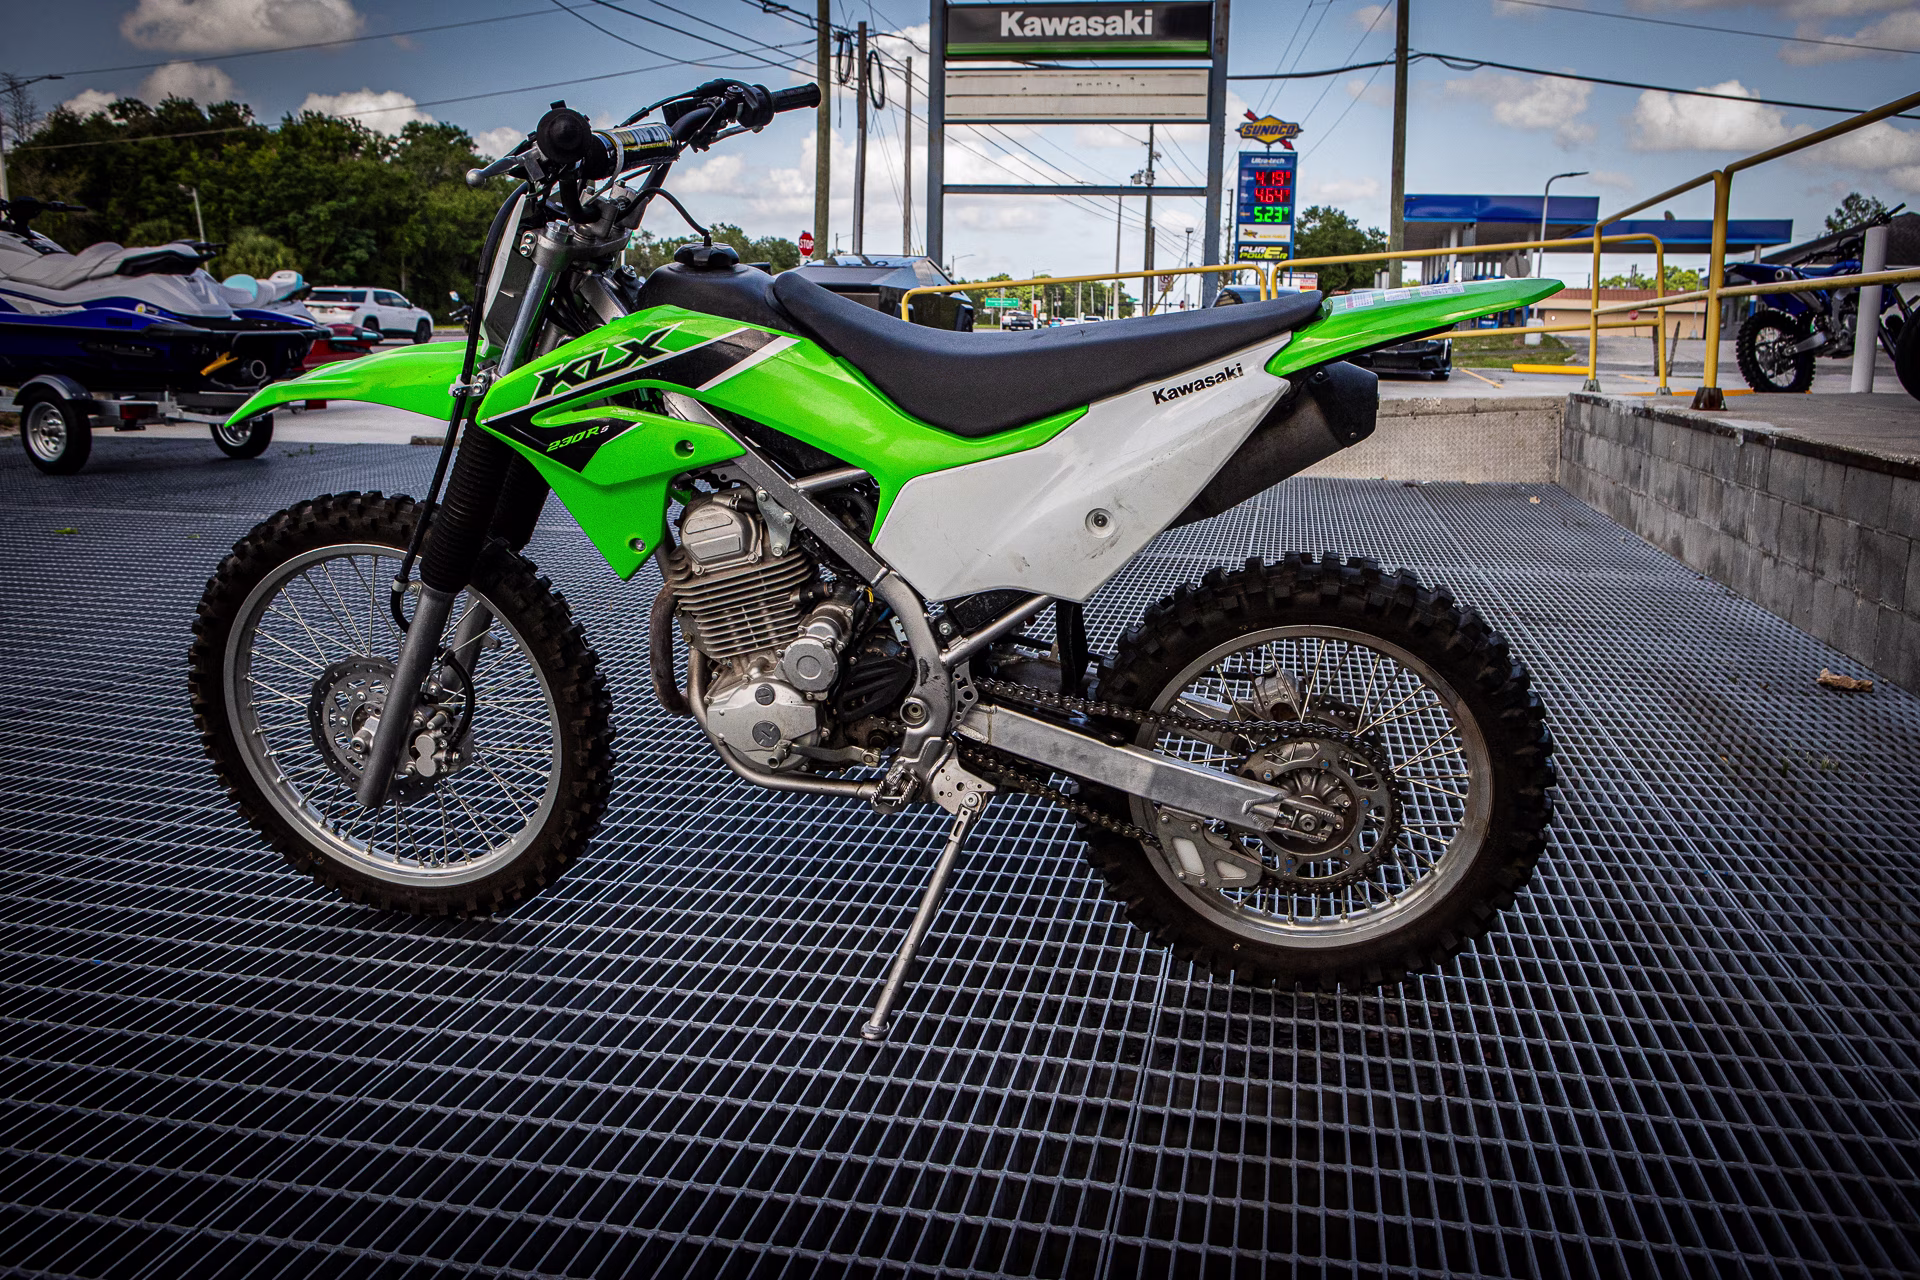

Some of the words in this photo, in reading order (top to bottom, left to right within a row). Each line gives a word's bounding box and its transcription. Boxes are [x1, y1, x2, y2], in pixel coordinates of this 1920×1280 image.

[1001, 9, 1153, 37] Kawasaki
[1243, 125, 1295, 136] SUNOCO
[800, 239, 814, 249] STOP
[531, 321, 683, 403] KLX
[1152, 363, 1244, 405] Kawasaki
